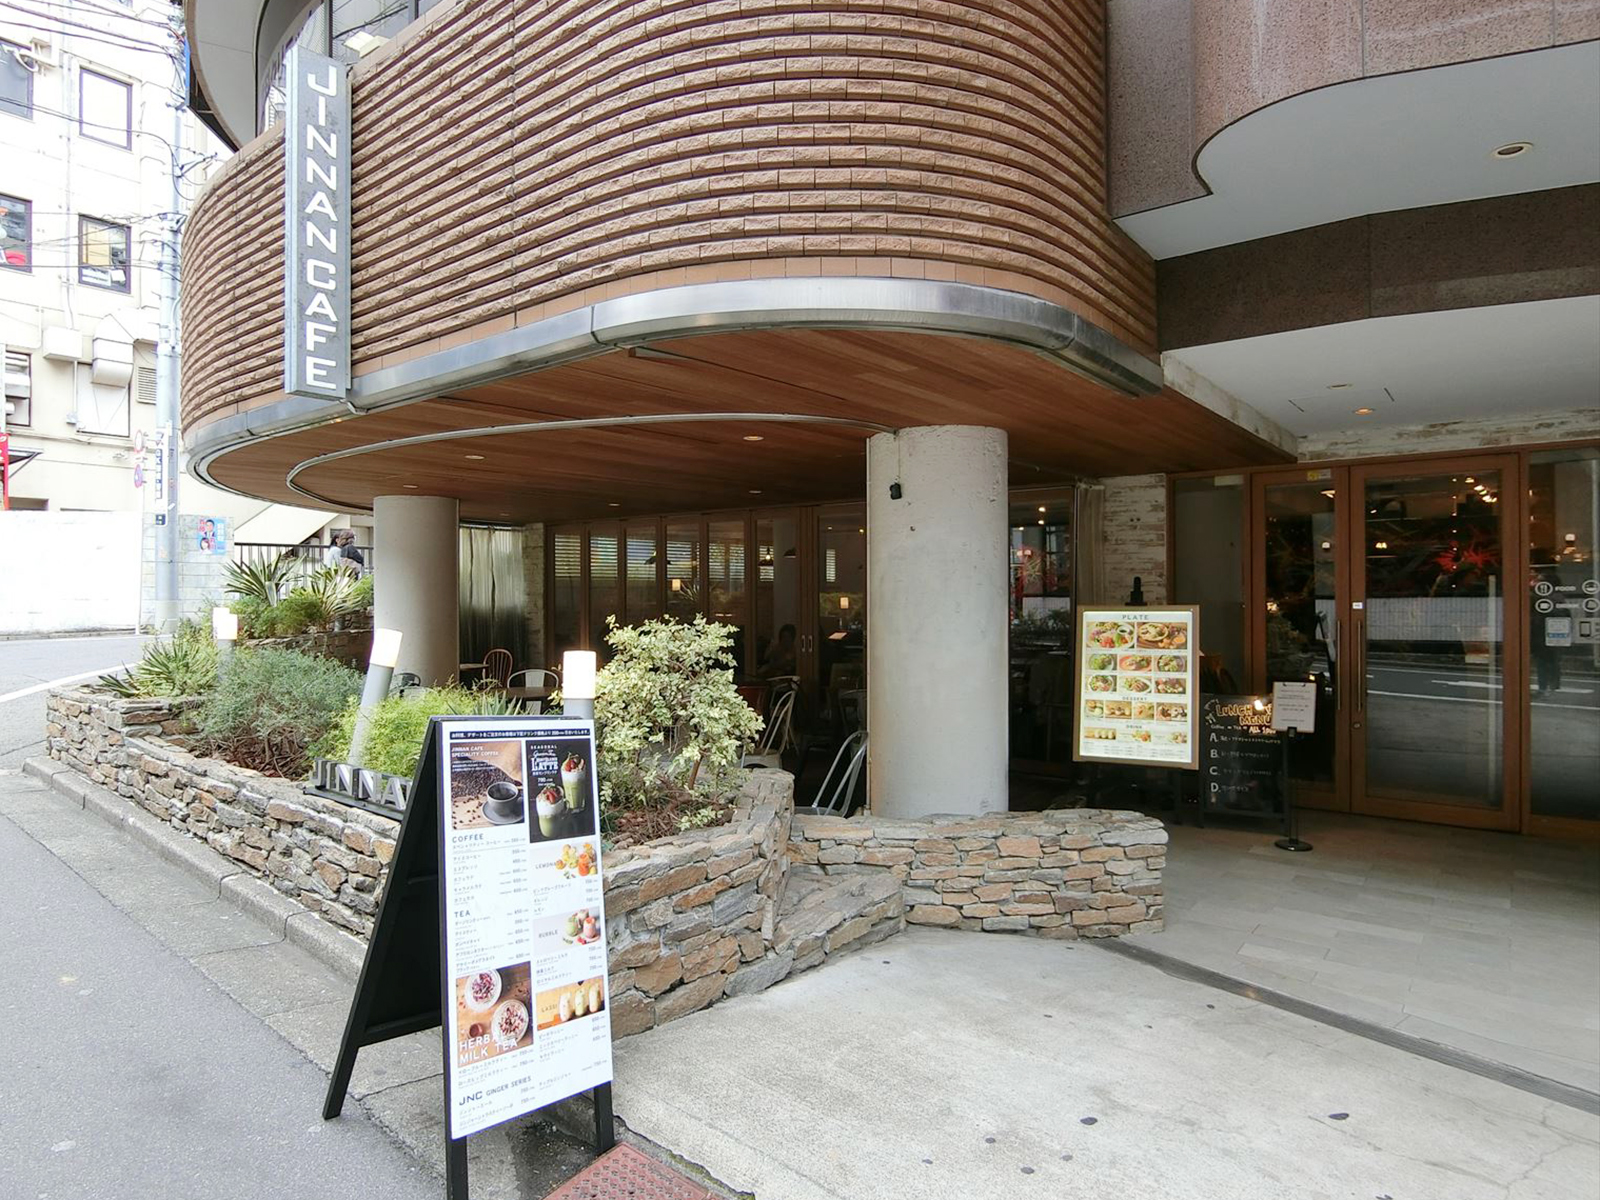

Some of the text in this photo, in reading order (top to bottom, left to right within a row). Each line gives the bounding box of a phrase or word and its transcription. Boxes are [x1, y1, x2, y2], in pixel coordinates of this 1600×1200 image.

[1215, 704, 1253, 717] LUNCH
[311, 758, 411, 812] JINNA
[452, 833, 484, 844] COFFEE
[454, 910, 471, 918] TEA
[460, 1034, 491, 1051] HERB
[460, 1038, 518, 1064] MILK TEA
[511, 1076, 532, 1088] SERIES
